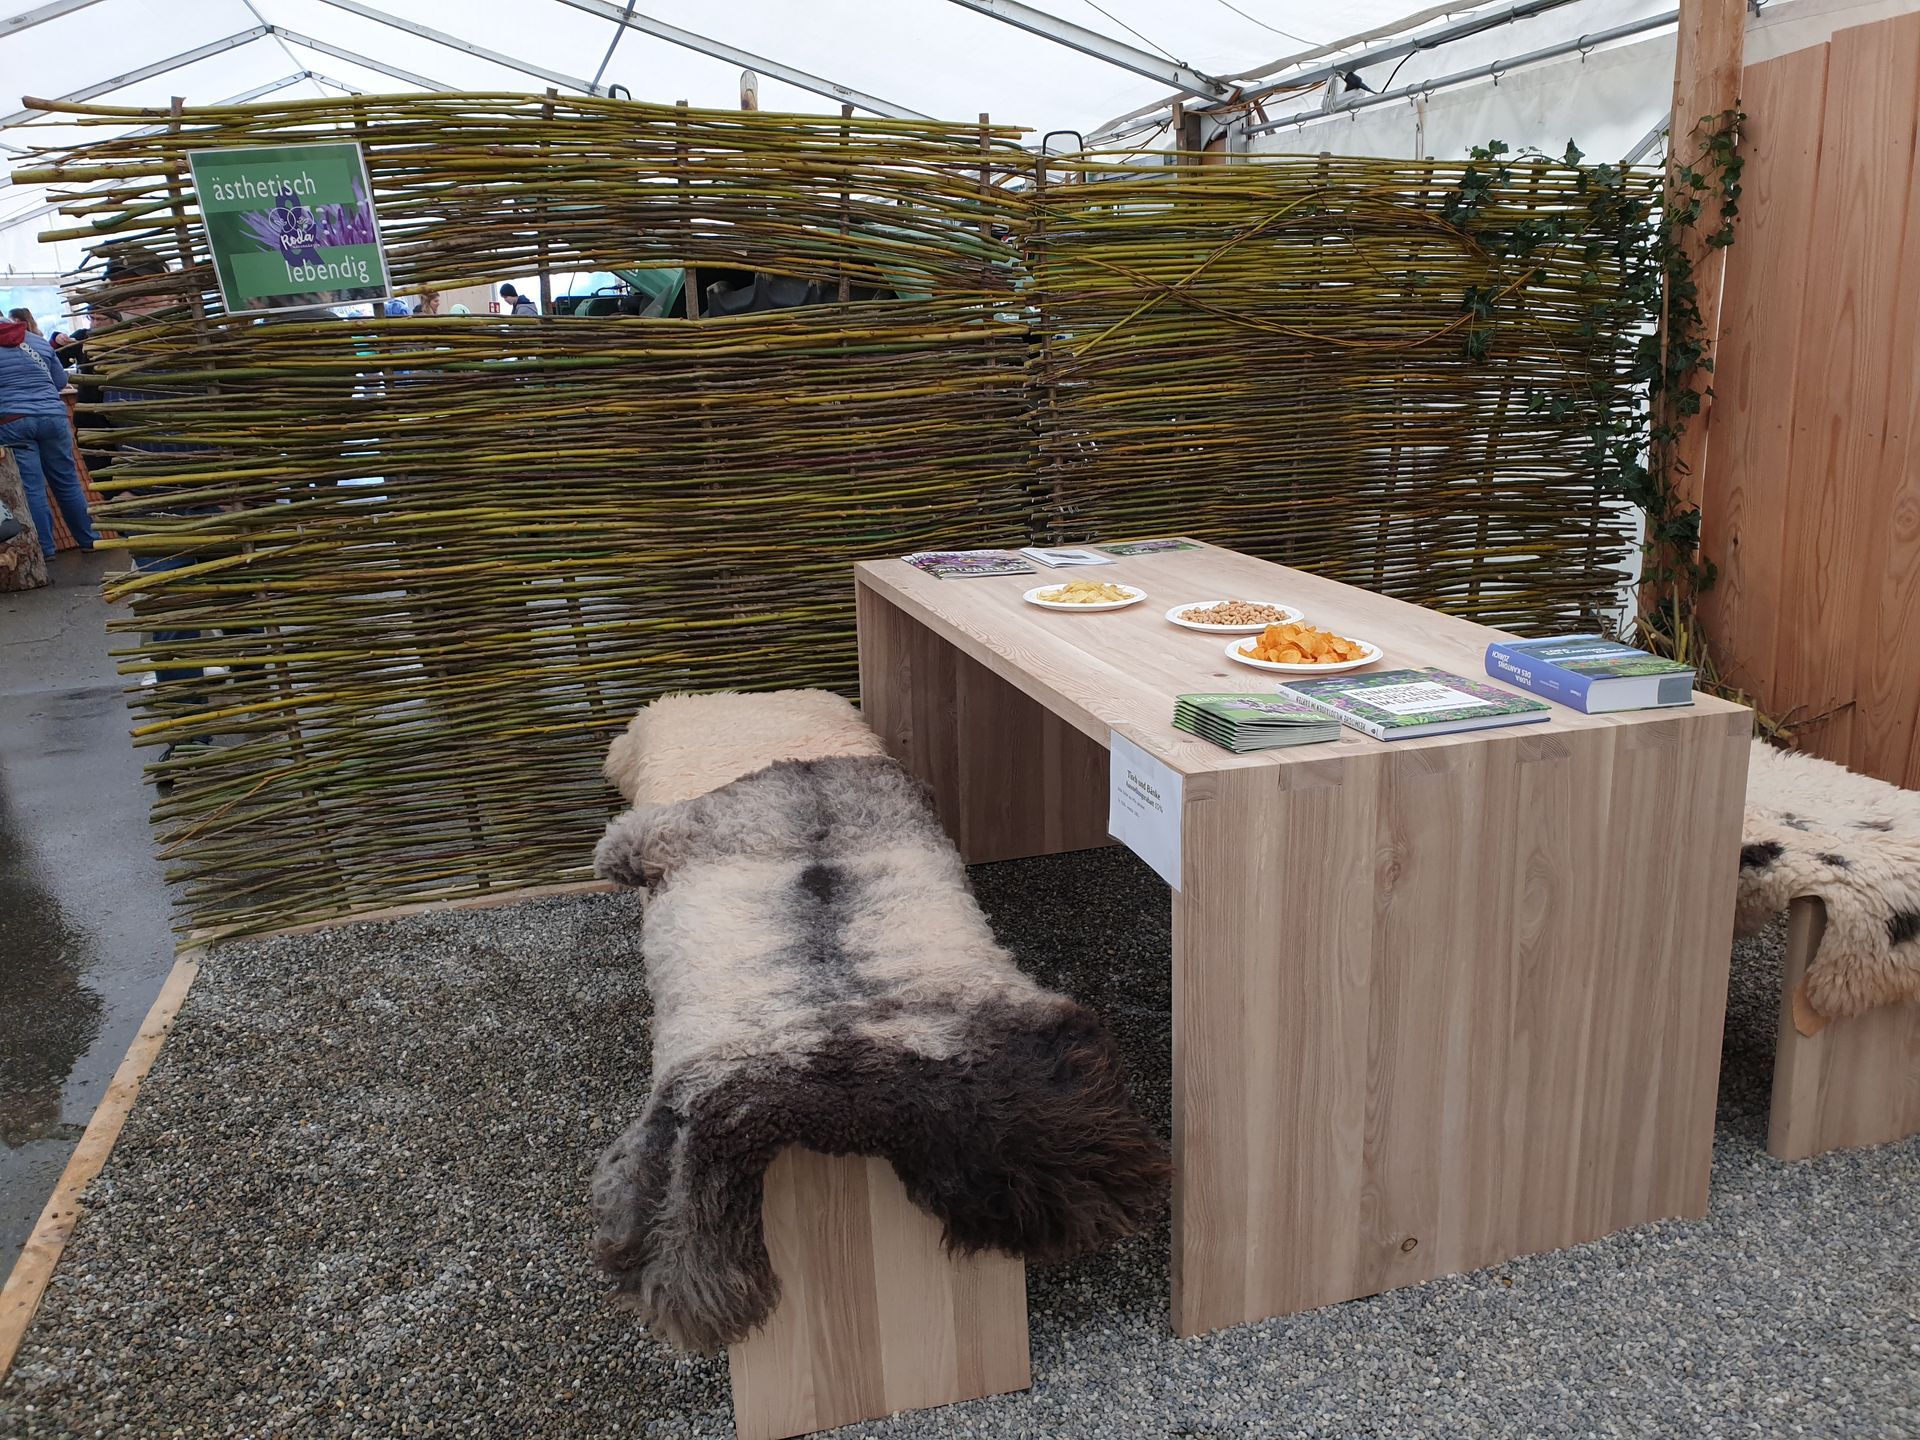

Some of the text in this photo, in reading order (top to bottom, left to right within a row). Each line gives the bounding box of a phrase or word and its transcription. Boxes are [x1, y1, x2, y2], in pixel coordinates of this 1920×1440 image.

[212, 171, 316, 200] ästhetisch
[280, 228, 315, 251] Roda
[285, 255, 370, 283] lebendig
[1515, 674, 1532, 686] FLORA
[1521, 669, 1532, 678] DES
[1138, 780, 1147, 791] und
[1146, 784, 1161, 801] Bänke
